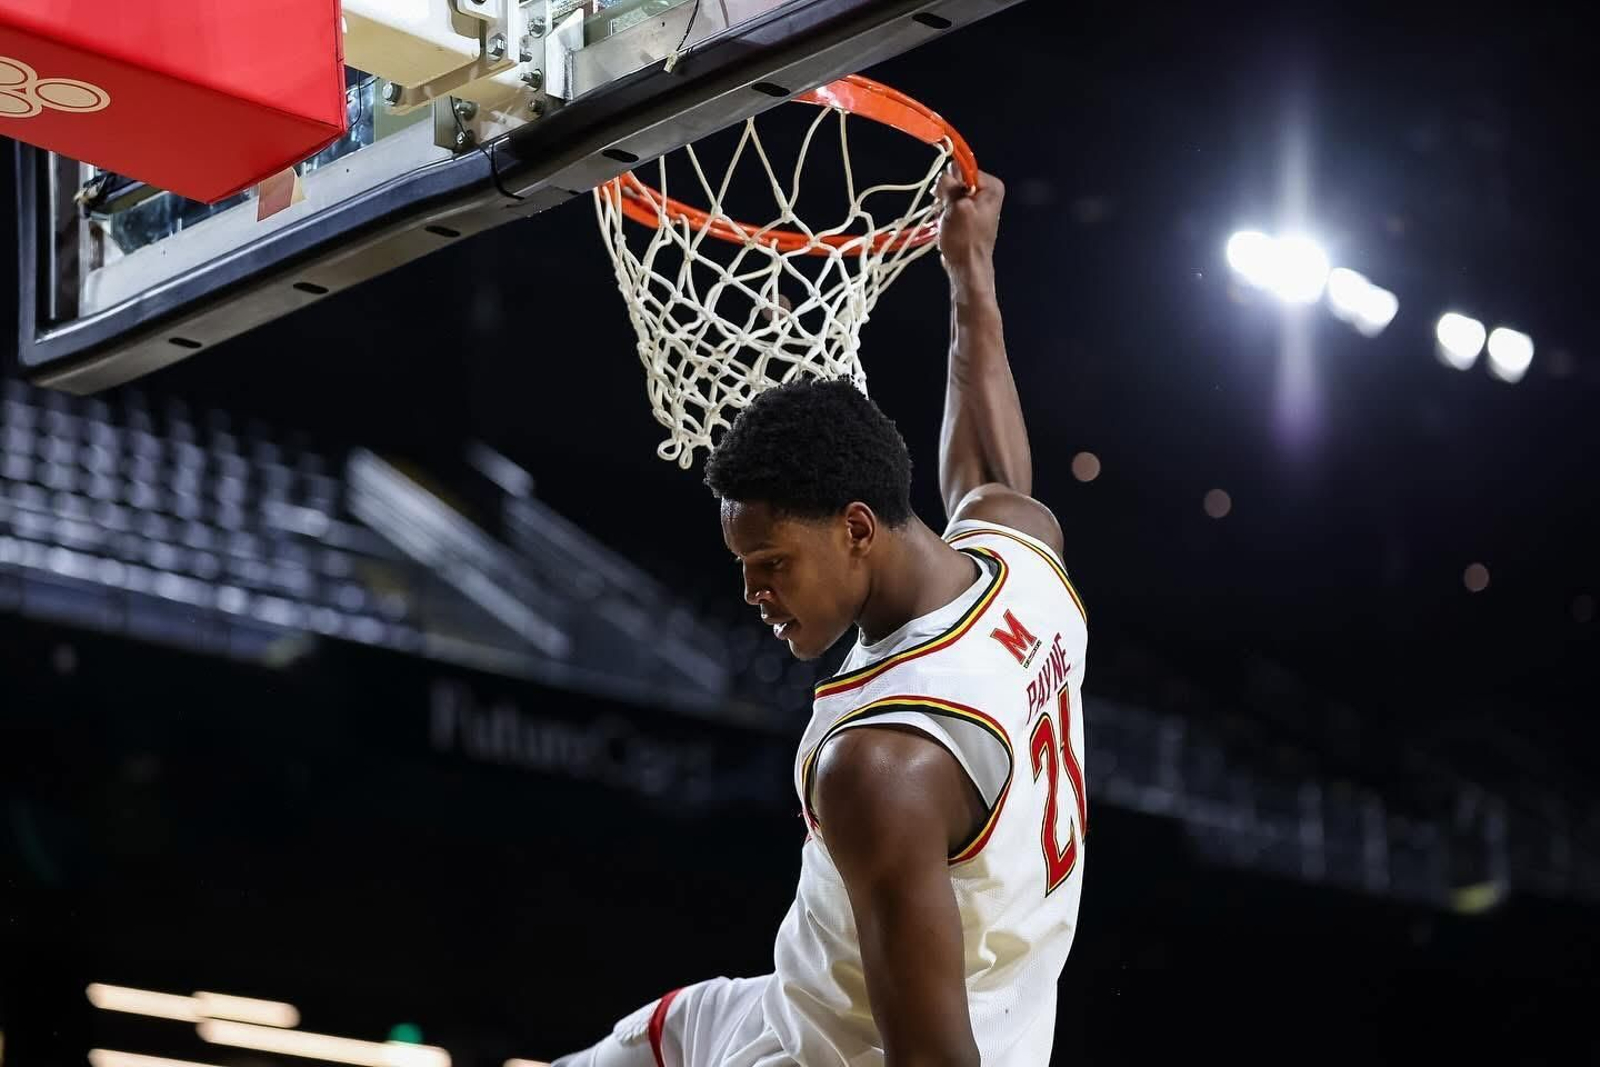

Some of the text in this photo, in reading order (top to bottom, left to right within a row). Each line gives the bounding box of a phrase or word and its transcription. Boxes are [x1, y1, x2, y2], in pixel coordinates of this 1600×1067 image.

[989, 608, 1038, 666] M
[1025, 632, 1071, 726] PAYNE
[1029, 680, 1087, 899] 21
